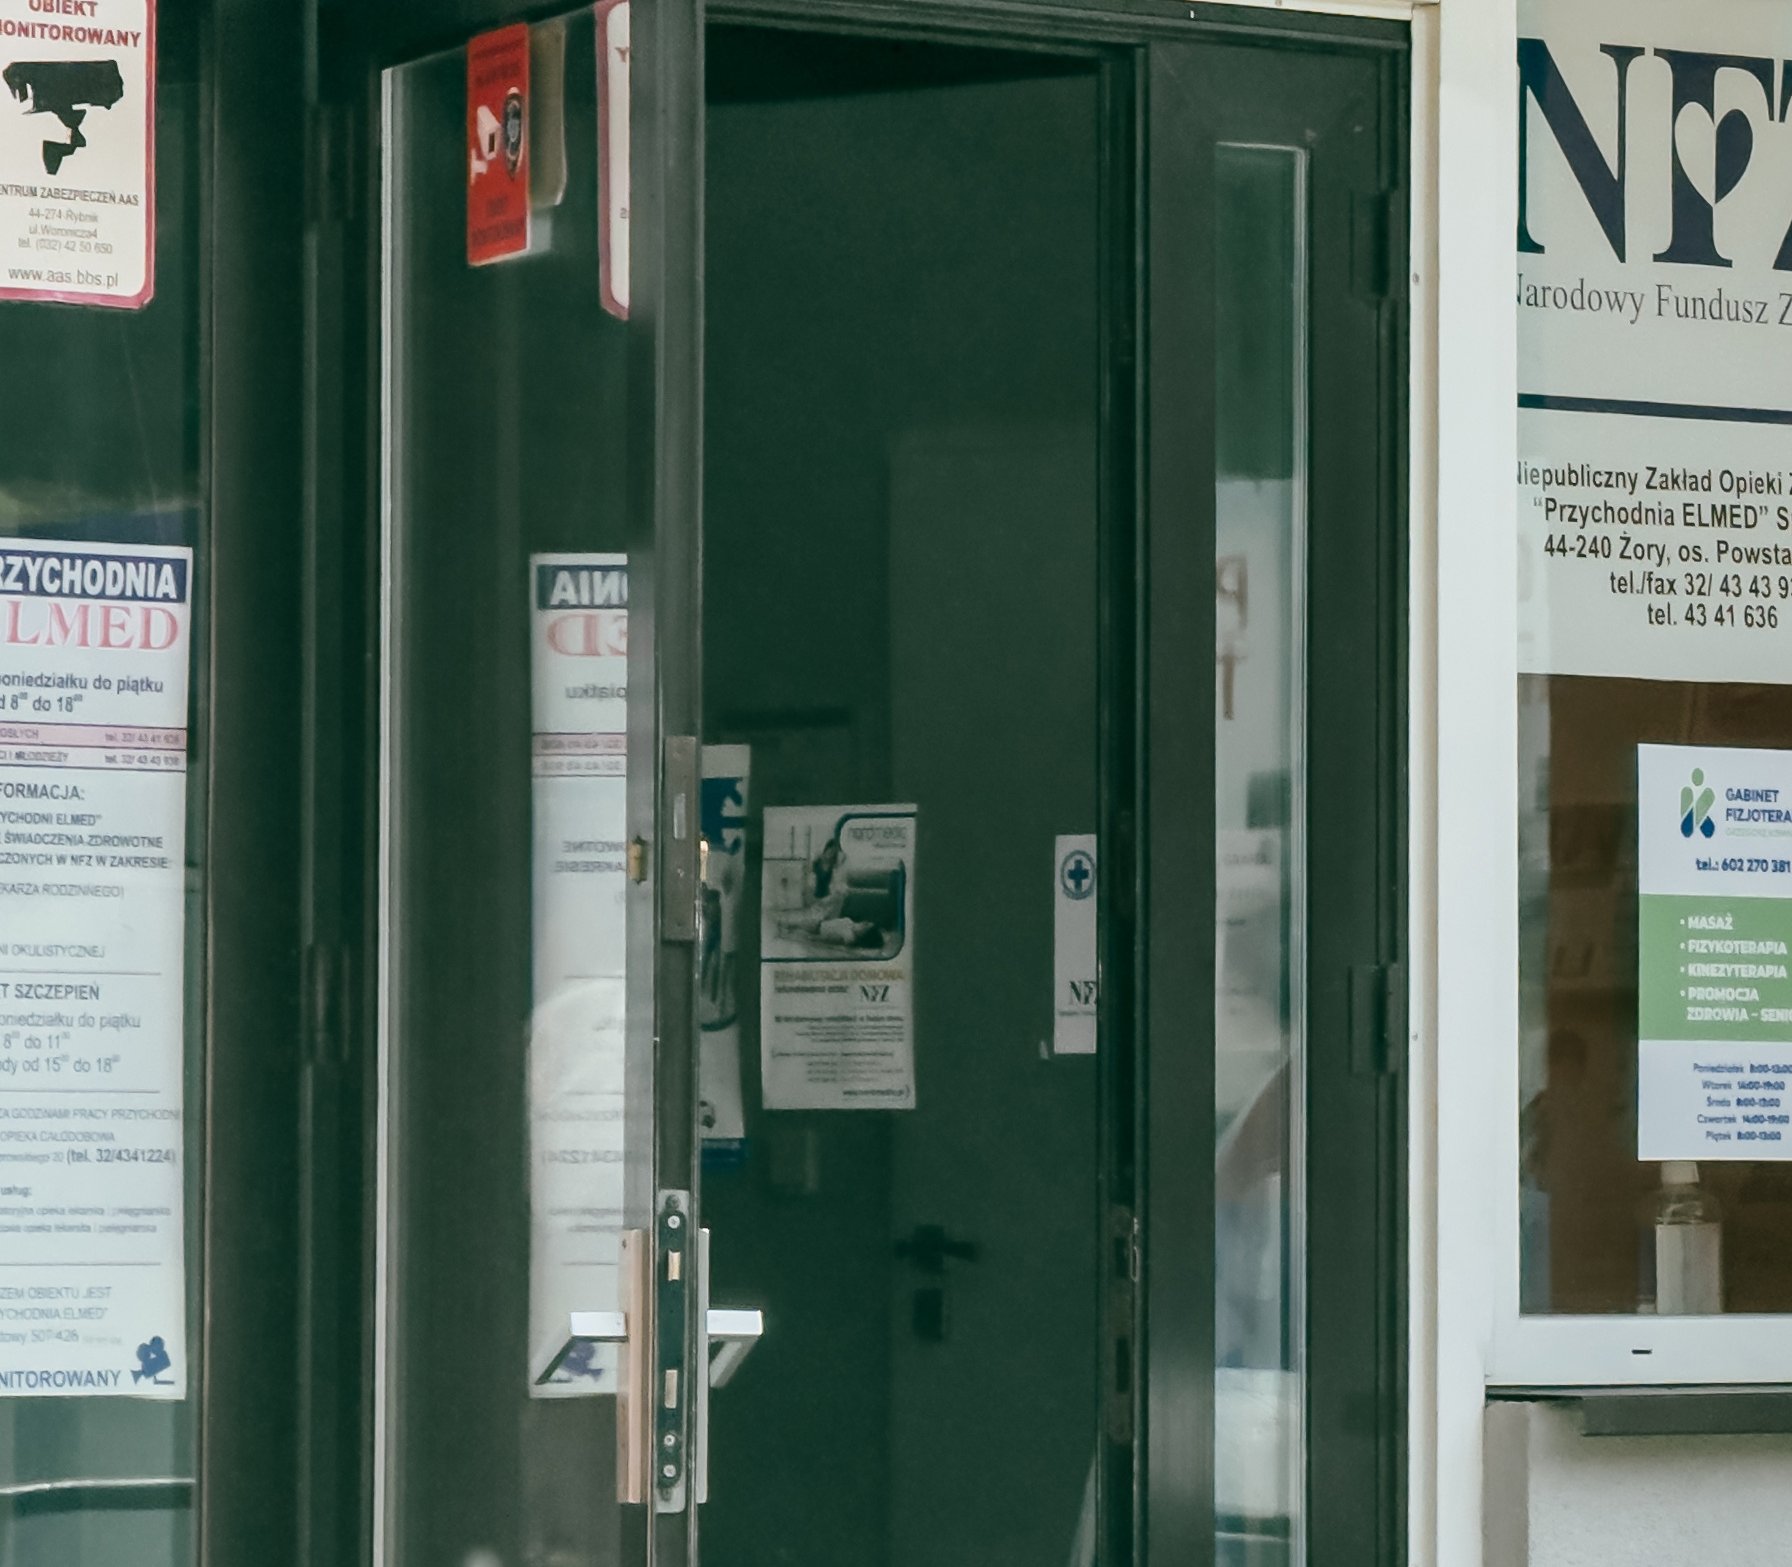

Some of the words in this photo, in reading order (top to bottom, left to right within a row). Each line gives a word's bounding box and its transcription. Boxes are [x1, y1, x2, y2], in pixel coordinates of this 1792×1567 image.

[28, 0, 98, 17] OBIEKT
[0, 19, 142, 48] ONITOROWANY
[116, 193, 139, 206] AAS
[1655, 284, 1769, 325] Fundusz
[1645, 466, 1712, 492] Zakład
[1718, 469, 1782, 499] Opieki
[1544, 534, 1612, 559] 44-240
[1618, 530, 1671, 568] Żory,
[1677, 544, 1709, 563] os.
[0, 555, 178, 600] ZYCHODNIA
[1609, 570, 1678, 596] tel./fax
[1684, 572, 1713, 597] 32/
[1719, 573, 1743, 598] 43
[1748, 575, 1772, 598] 43
[1647, 601, 1677, 626] tel.
[1684, 602, 1707, 627] 43
[1714, 603, 1735, 628] 41
[1743, 604, 1779, 629] 636
[92, 675, 112, 690] do
[116, 676, 164, 694] piątku
[32, 696, 51, 712] do
[1725, 787, 1779, 803] GABINET
[1721, 858, 1745, 872] 602
[1747, 859, 1769, 873] 270
[1771, 860, 1792, 873] 381
[1687, 912, 1734, 931] MASAŻ
[1687, 939, 1788, 955] FIZYKOTERAPIA
[1687, 963, 1788, 979] KINEZYTERAPIA
[1687, 986, 1760, 1001] PROMOCJA
[77, 1012, 96, 1028] do
[99, 1014, 142, 1032] piątku
[1686, 1006, 1750, 1022] ZDROWIA
[23, 1033, 42, 1050] do
[22, 1058, 40, 1073] od
[72, 1059, 91, 1074] do
